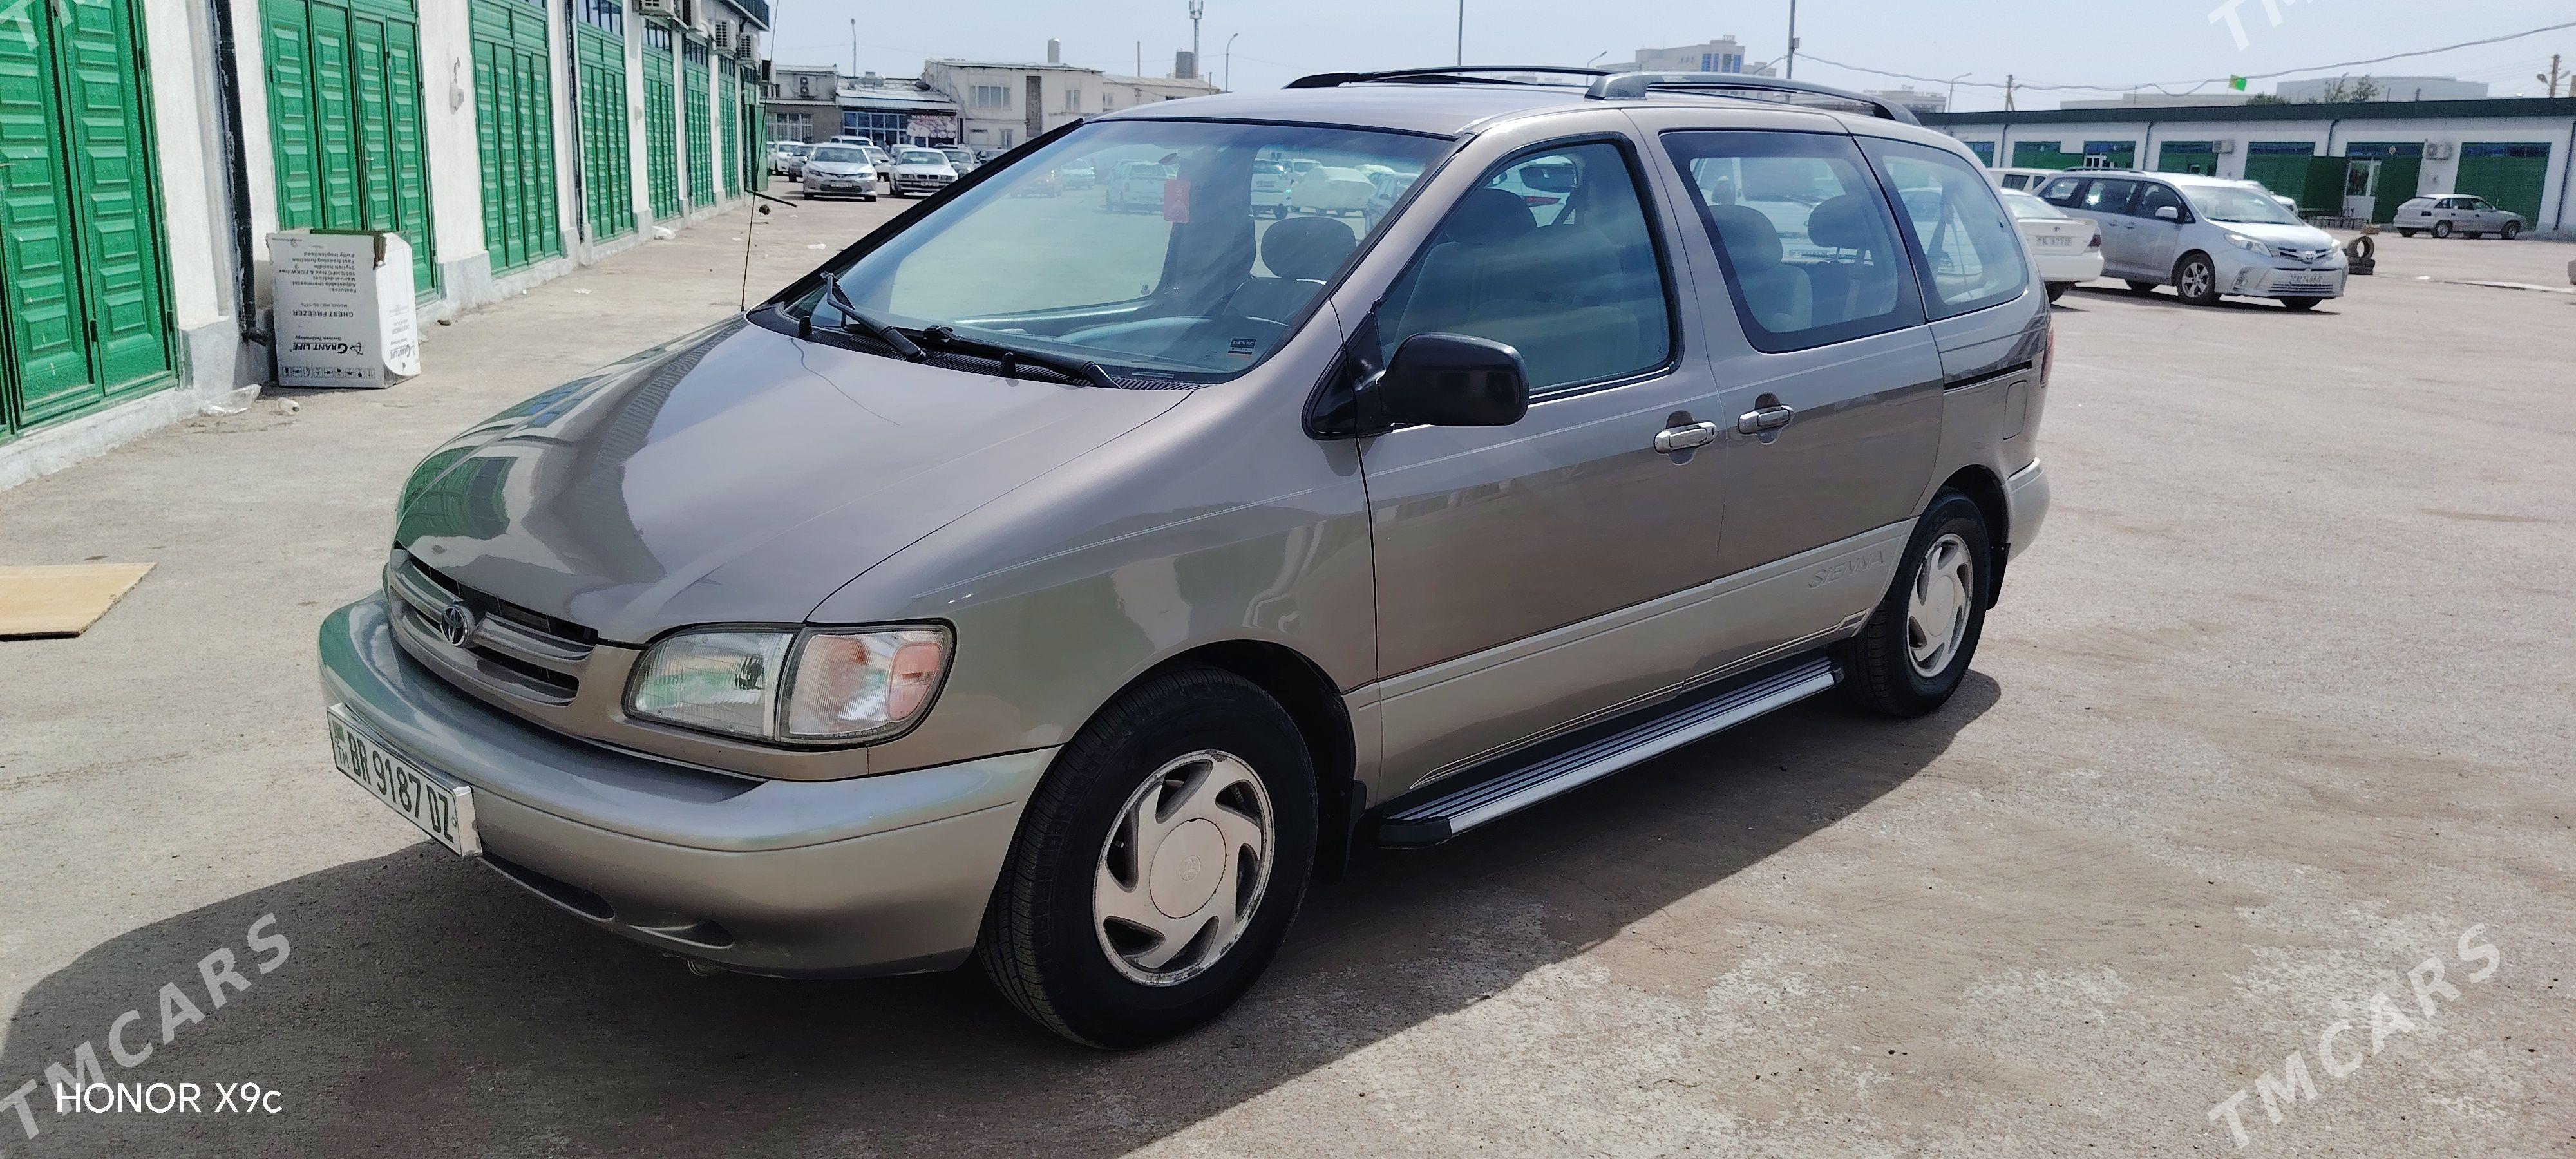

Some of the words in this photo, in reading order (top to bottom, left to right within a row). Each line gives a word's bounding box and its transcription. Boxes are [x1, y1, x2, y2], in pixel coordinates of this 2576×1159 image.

[292, 343, 310, 351] LIFE
[312, 343, 348, 354] GRANT
[1808, 550, 1884, 590] SIENNA
[337, 744, 350, 770] TM
[346, 730, 372, 786] BR
[372, 750, 421, 819] 9187
[426, 784, 454, 844] DZ
